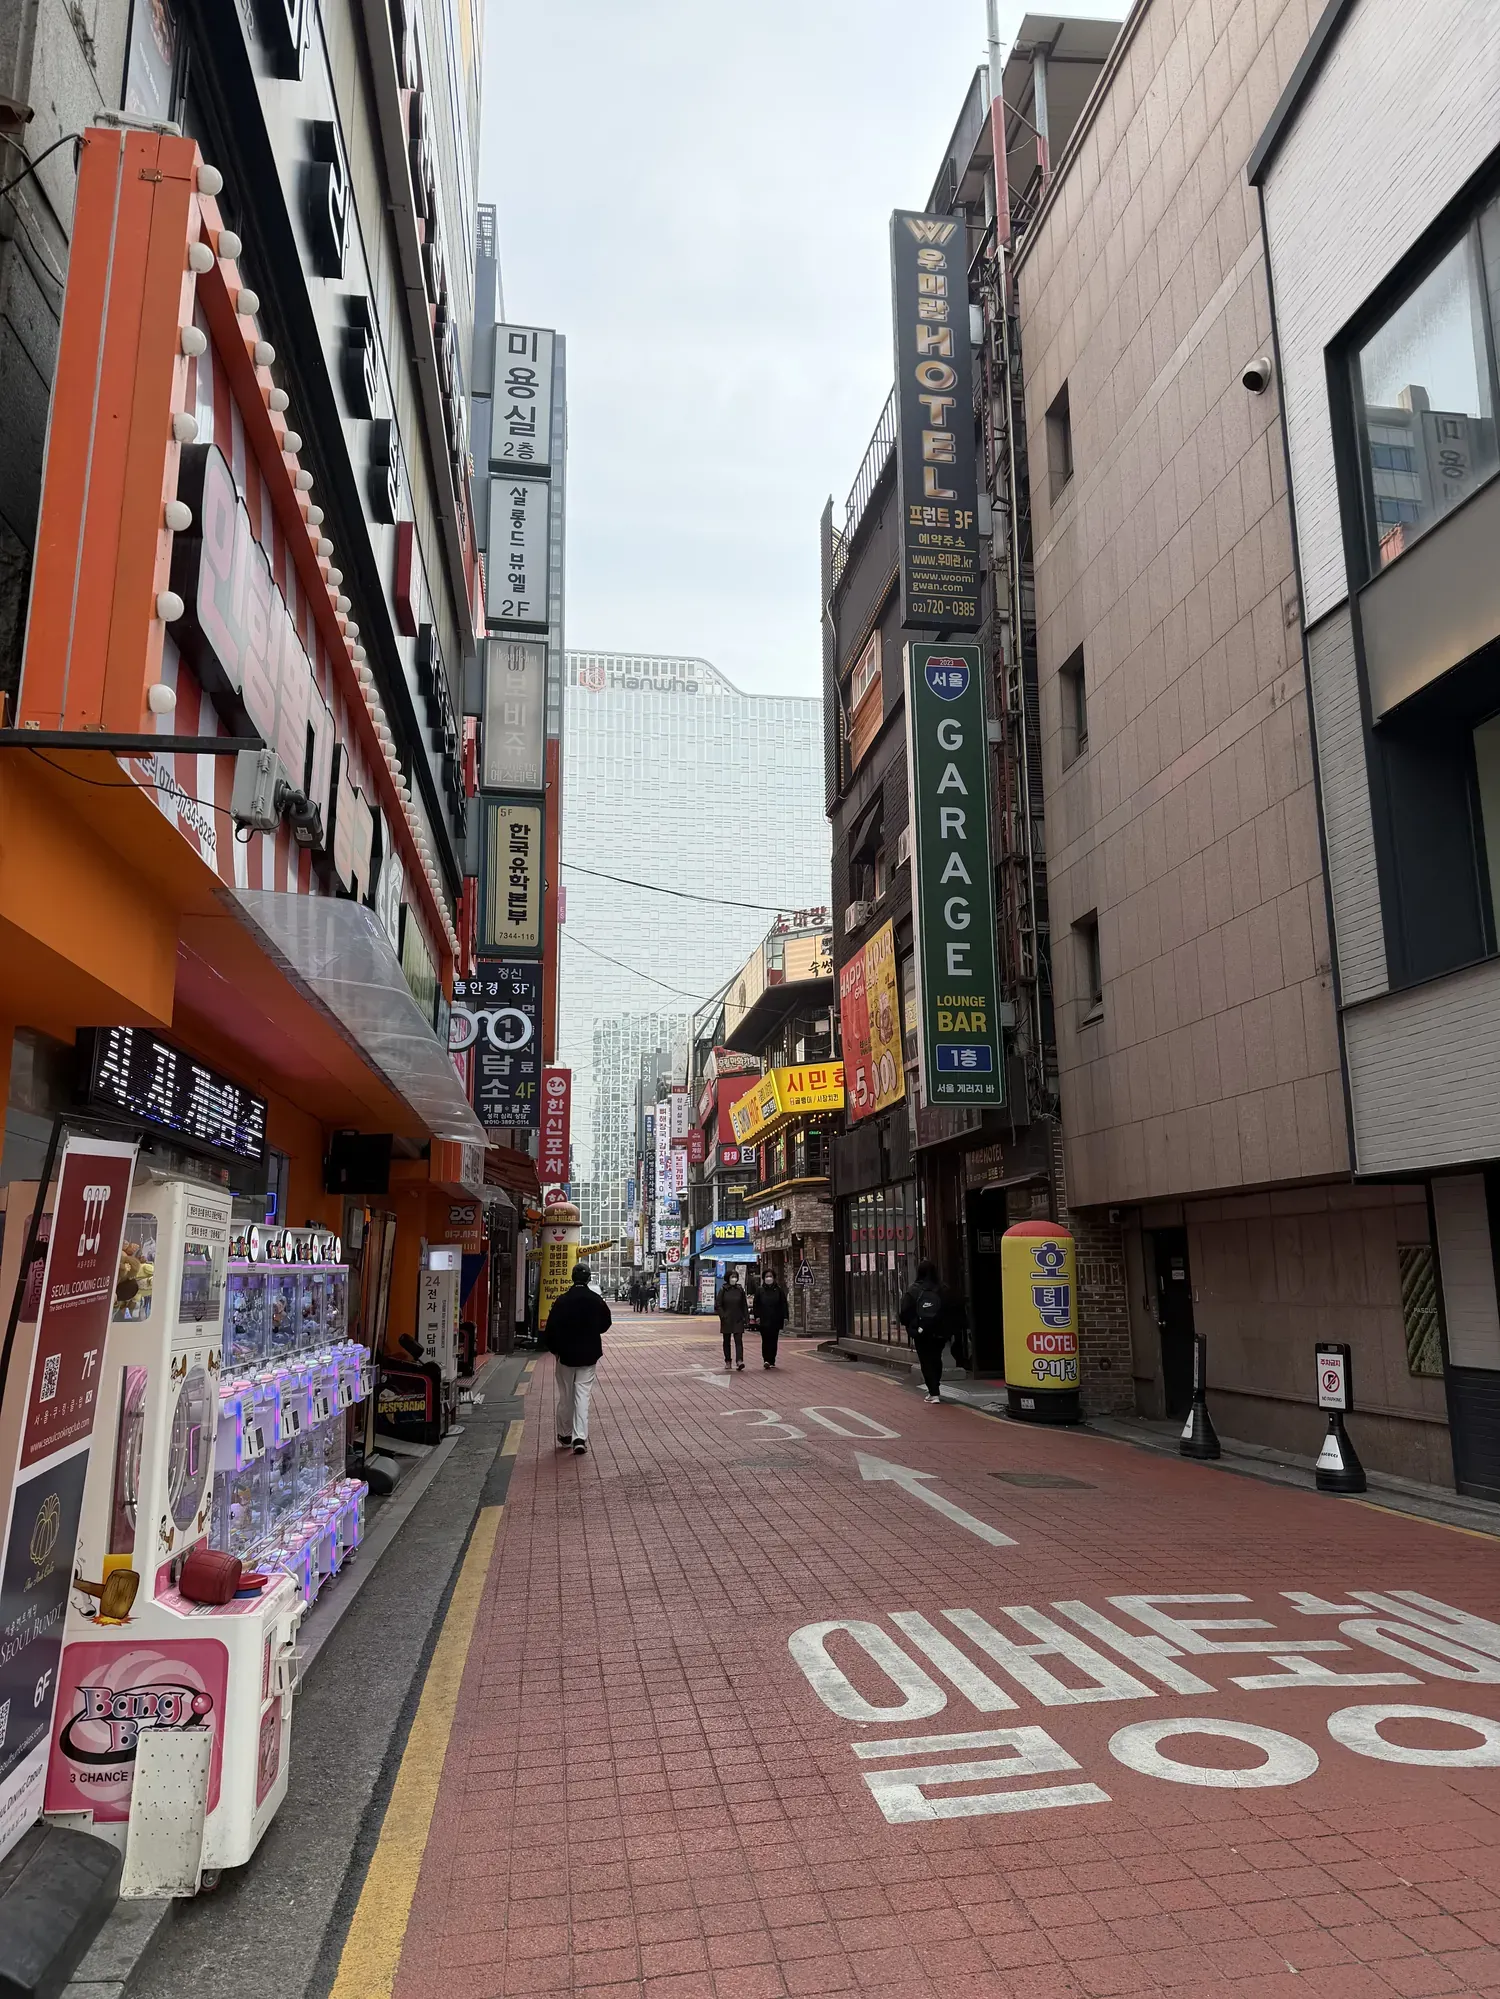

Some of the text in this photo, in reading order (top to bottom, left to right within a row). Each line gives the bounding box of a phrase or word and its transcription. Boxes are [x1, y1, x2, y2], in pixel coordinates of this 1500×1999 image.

[504, 331, 540, 438] 미용실
[914, 324, 958, 502] HOTEL
[503, 440, 535, 461] 2층
[909, 504, 974, 531] 프런트 3F
[917, 532, 966, 548] 예약주소
[911, 553, 974, 571] www.우미관.kr
[911, 570, 975, 585] www.woomi
[911, 580, 965, 594] gwan.com
[500, 599, 531, 617] 2F
[610, 672, 699, 694] Hanwha
[931, 671, 964, 689] 서울
[935, 717, 974, 978] GARAGE
[498, 967, 522, 980] 정신
[511, 982, 530, 995] 3F
[936, 995, 987, 1009] LOUNGE
[936, 1011, 988, 1033] BAR
[950, 1049, 978, 1068] 1층
[514, 1081, 536, 1099] 4F
[937, 1083, 995, 1094] 서울 게러지 바
[544, 1098, 565, 1176] 한신포차
[715, 1225, 745, 1239] 해산물
[51, 1275, 110, 1298] SEOUL COOKING CLUB
[425, 1276, 440, 1287] 24
[1030, 1241, 1072, 1328] 호텔
[421, 1289, 437, 1358] 전자 담배
[1032, 1337, 1076, 1352] HOTEL
[81, 1349, 98, 1380] 7F
[1031, 1357, 1078, 1381] 우미관
[1320, 1358, 1340, 1367] 주차금지
[378, 1399, 426, 1413] DESPERADO
[719, 1405, 901, 1442] 30
[0, 1601, 64, 1668] SEOUL BUNDT
[34, 1667, 52, 1709] 6F
[83, 1687, 183, 1724] Bang
[79, 1771, 128, 1784] CHANCE
